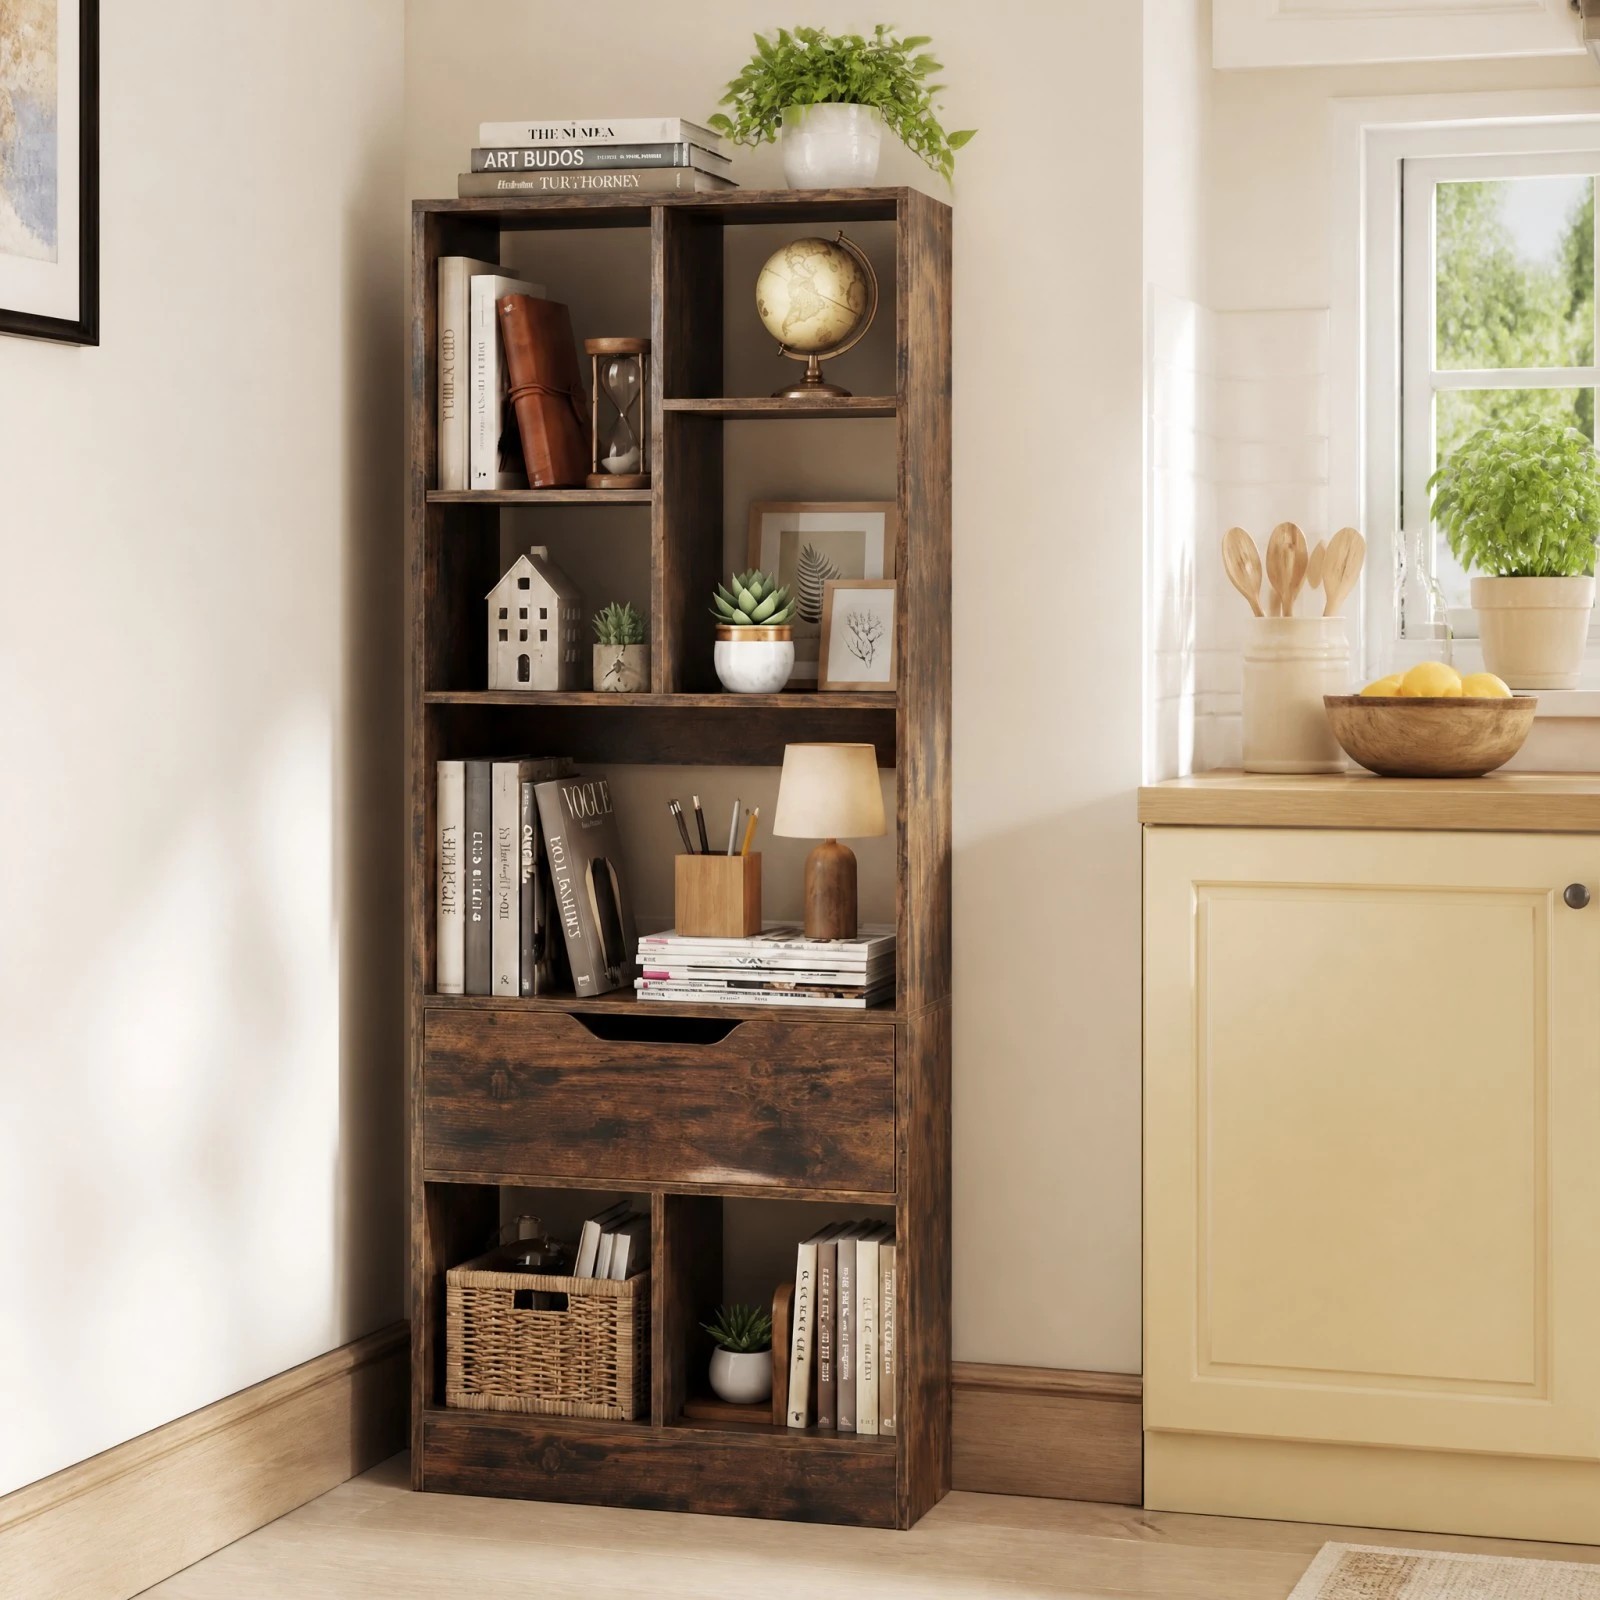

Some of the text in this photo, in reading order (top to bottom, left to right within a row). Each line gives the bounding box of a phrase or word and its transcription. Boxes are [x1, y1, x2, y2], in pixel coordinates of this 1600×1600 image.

[528, 128, 558, 139] THE
[484, 150, 518, 168] ART
[524, 149, 584, 167] BUDOS
[562, 780, 613, 820] VOGUE
